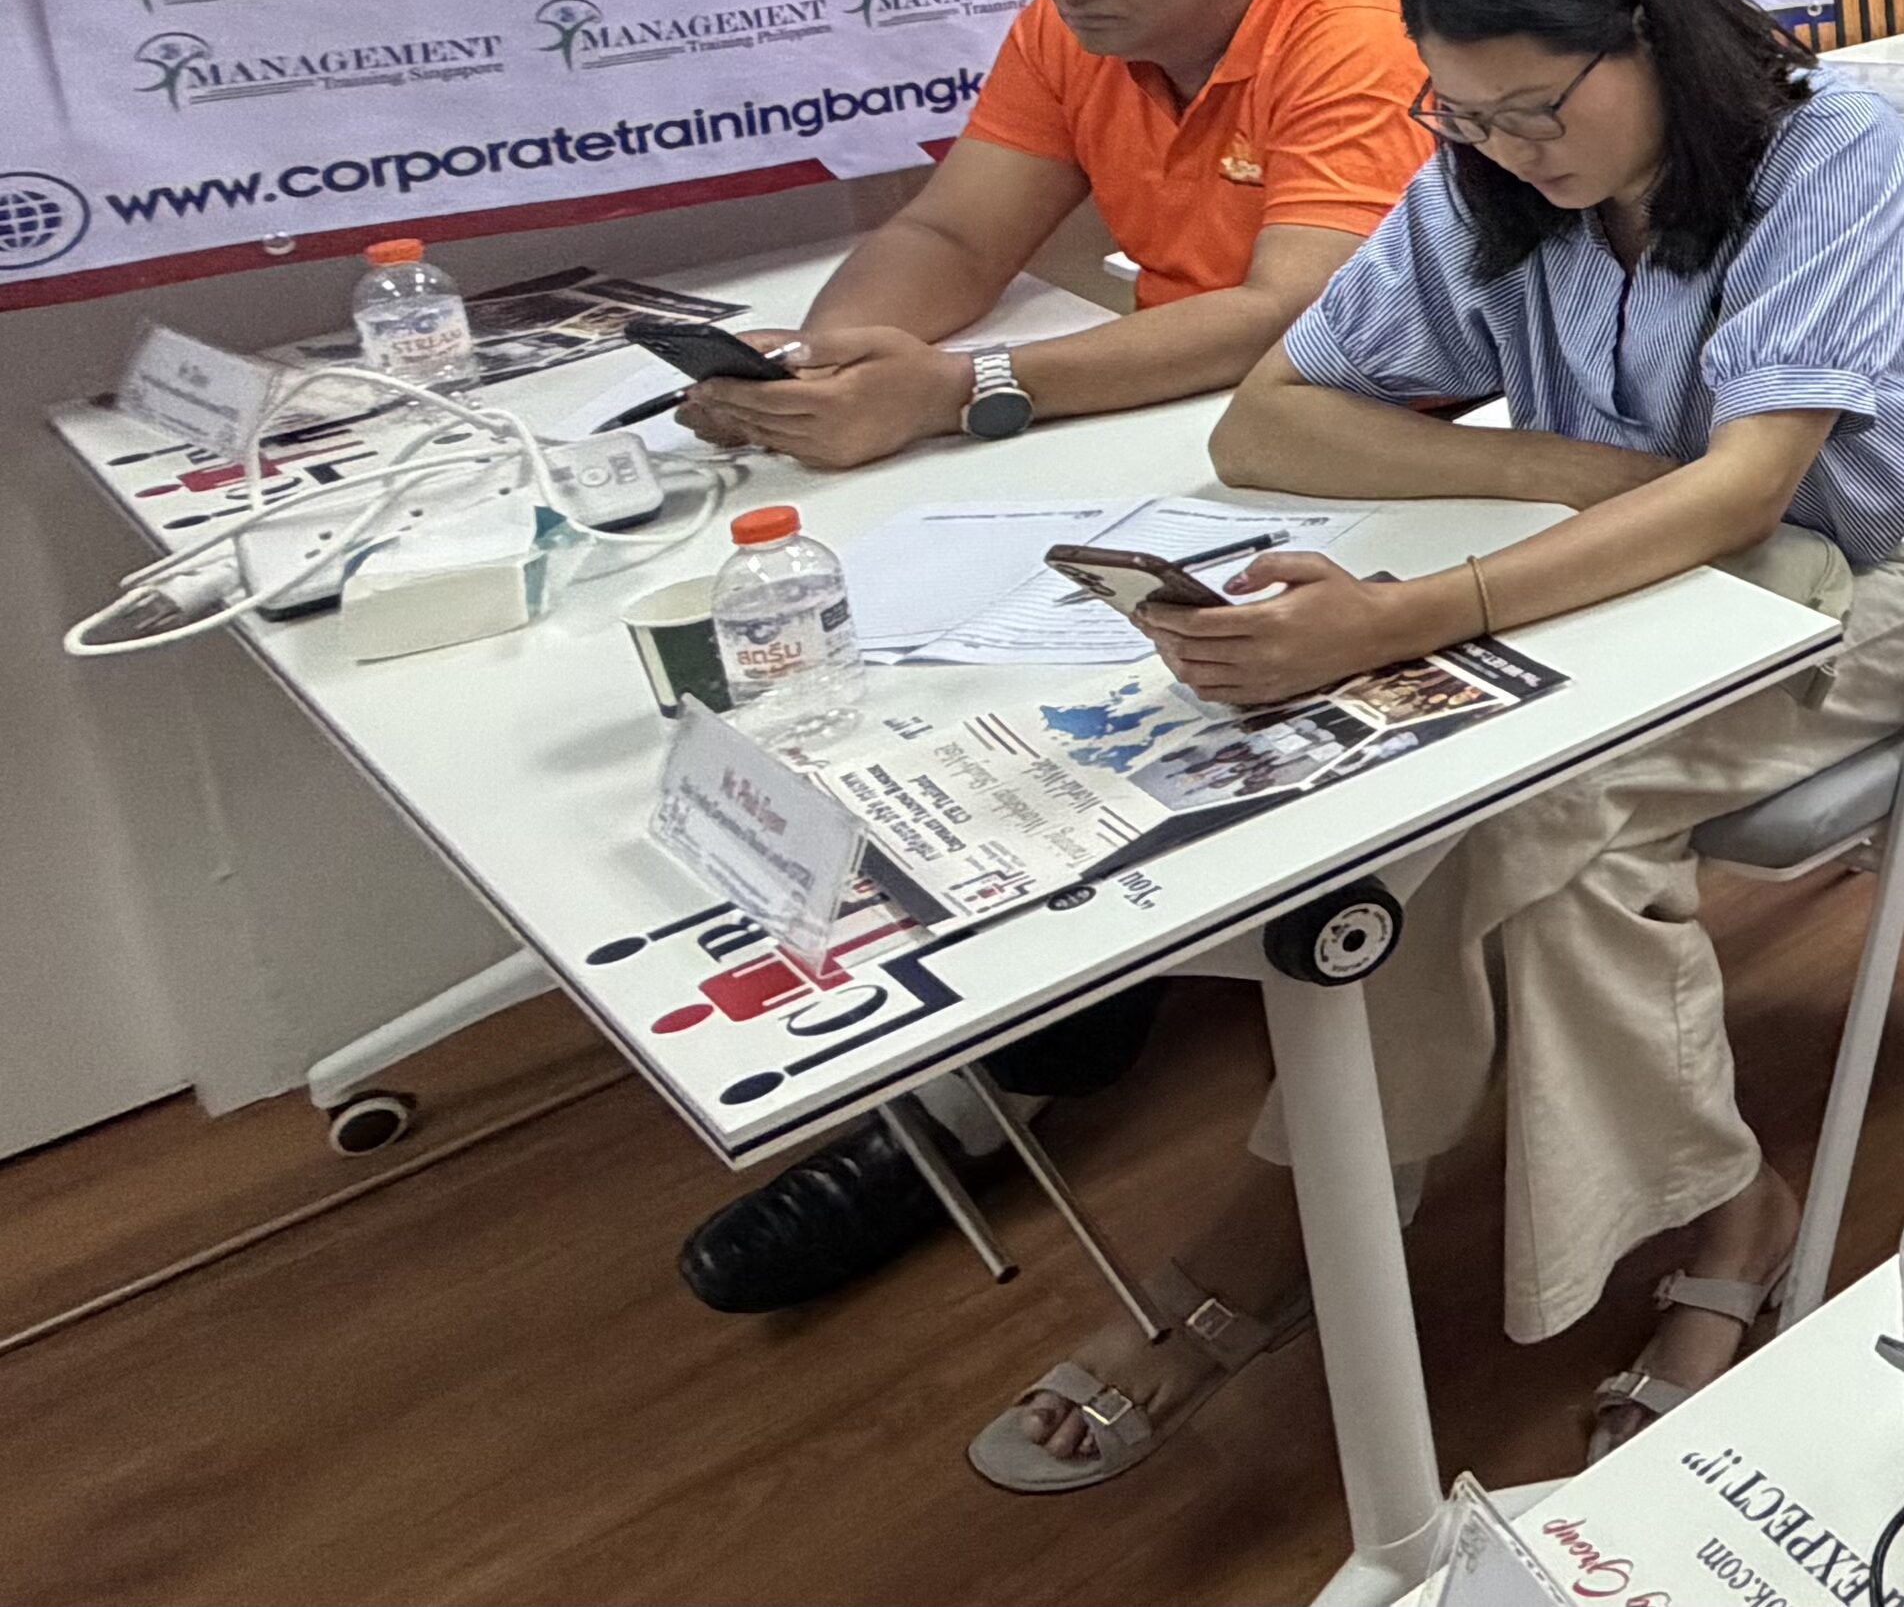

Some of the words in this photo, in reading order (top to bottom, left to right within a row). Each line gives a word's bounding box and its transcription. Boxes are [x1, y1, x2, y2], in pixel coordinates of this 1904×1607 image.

[582, 0, 827, 52] MANAGEMENT
[188, 36, 502, 89] MANAGEMENT
[1541, 1517, 1633, 1600] Group
